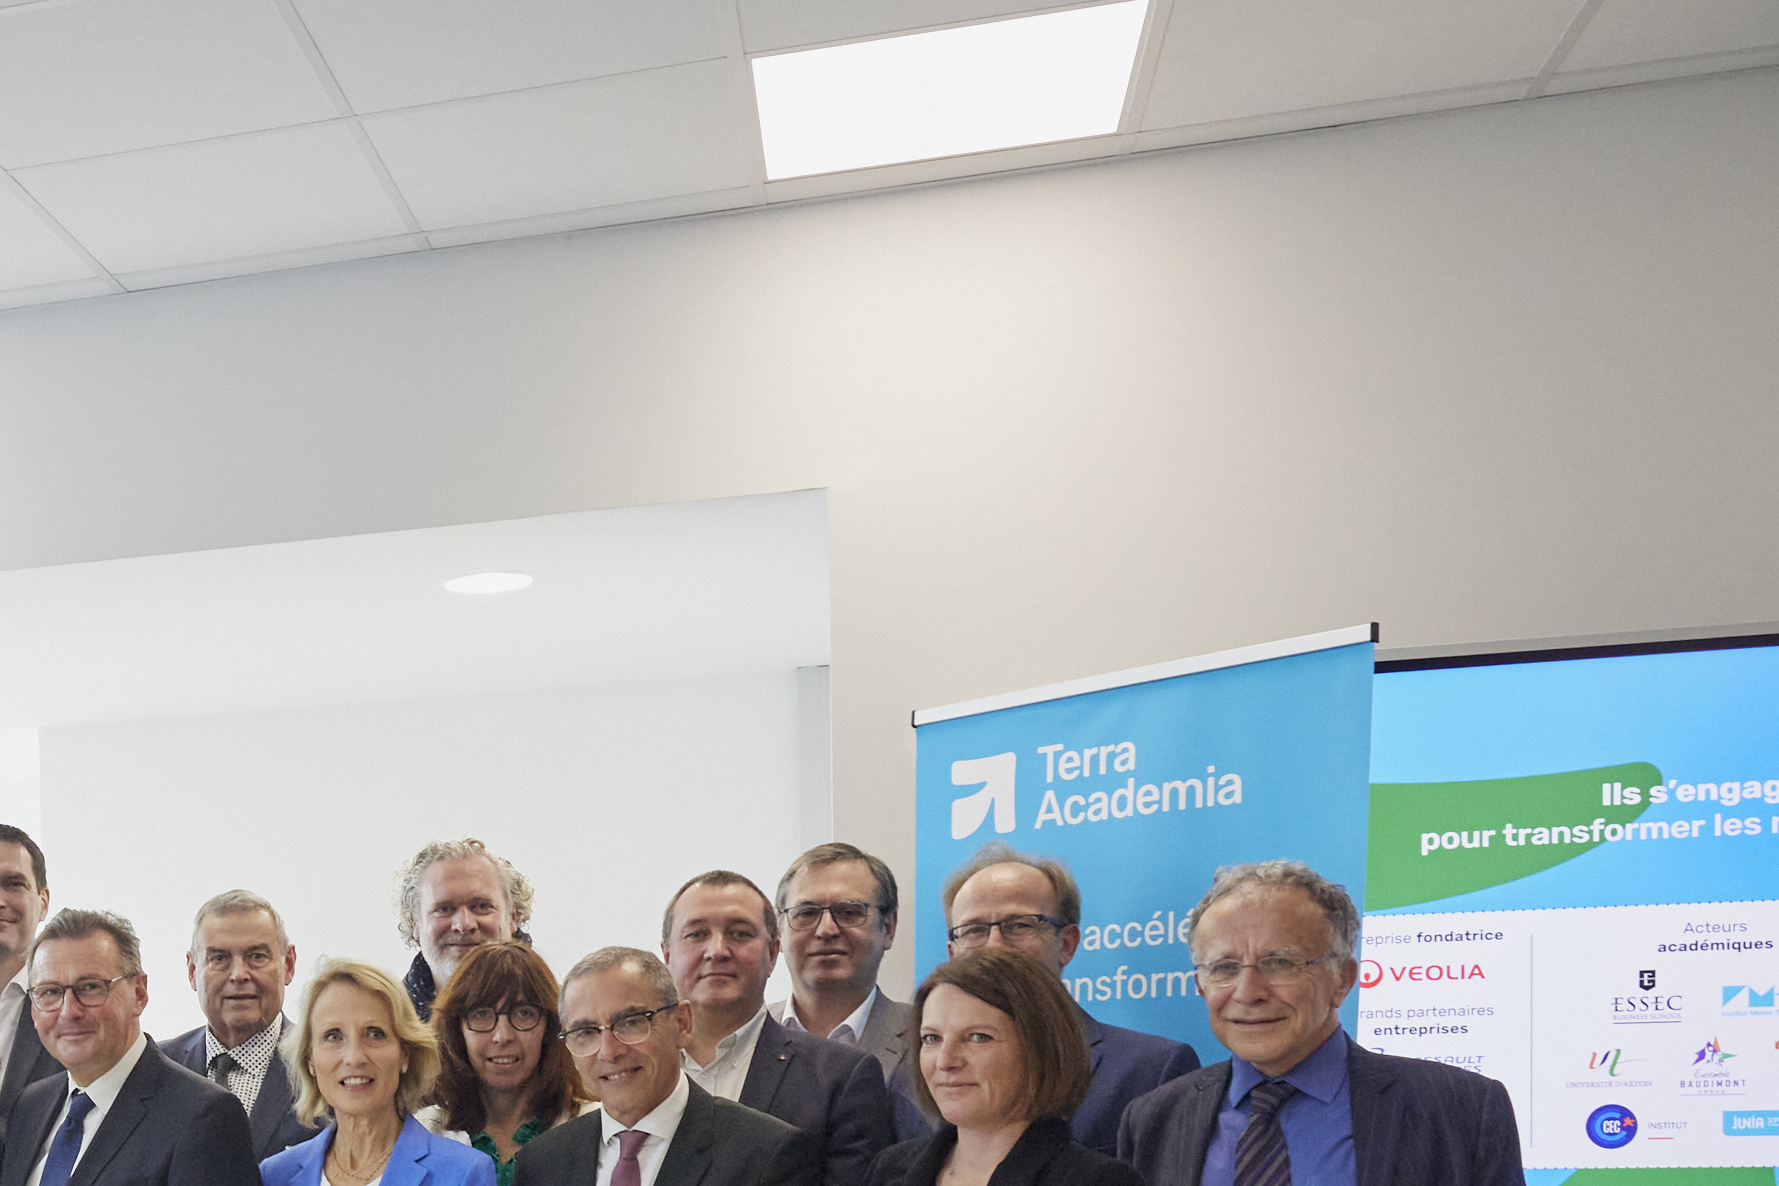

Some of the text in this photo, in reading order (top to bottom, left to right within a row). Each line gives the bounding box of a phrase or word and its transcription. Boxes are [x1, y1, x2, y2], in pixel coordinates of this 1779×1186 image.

[1037, 741, 1136, 783] Terra
[1034, 765, 1243, 829] Academia
[1602, 779, 1779, 807] Ils s'engag
[1421, 828, 1496, 856] pour
[1503, 818, 1706, 847] transformer
[1714, 813, 1762, 836] les
[1683, 922, 1748, 934] Acteurs
[1416, 930, 1504, 944] fondatrice
[1657, 939, 1774, 953] académiques
[1389, 964, 1486, 982] VEOLIA
[1611, 995, 1682, 1012] ESSEC
[1407, 1004, 1495, 1020] partenaires
[1374, 1023, 1469, 1037] entreprises
[1680, 1079, 1746, 1088] BAUDIMONT
[1602, 1120, 1621, 1133] CEC
[1647, 1121, 1688, 1130] INSTITUT
